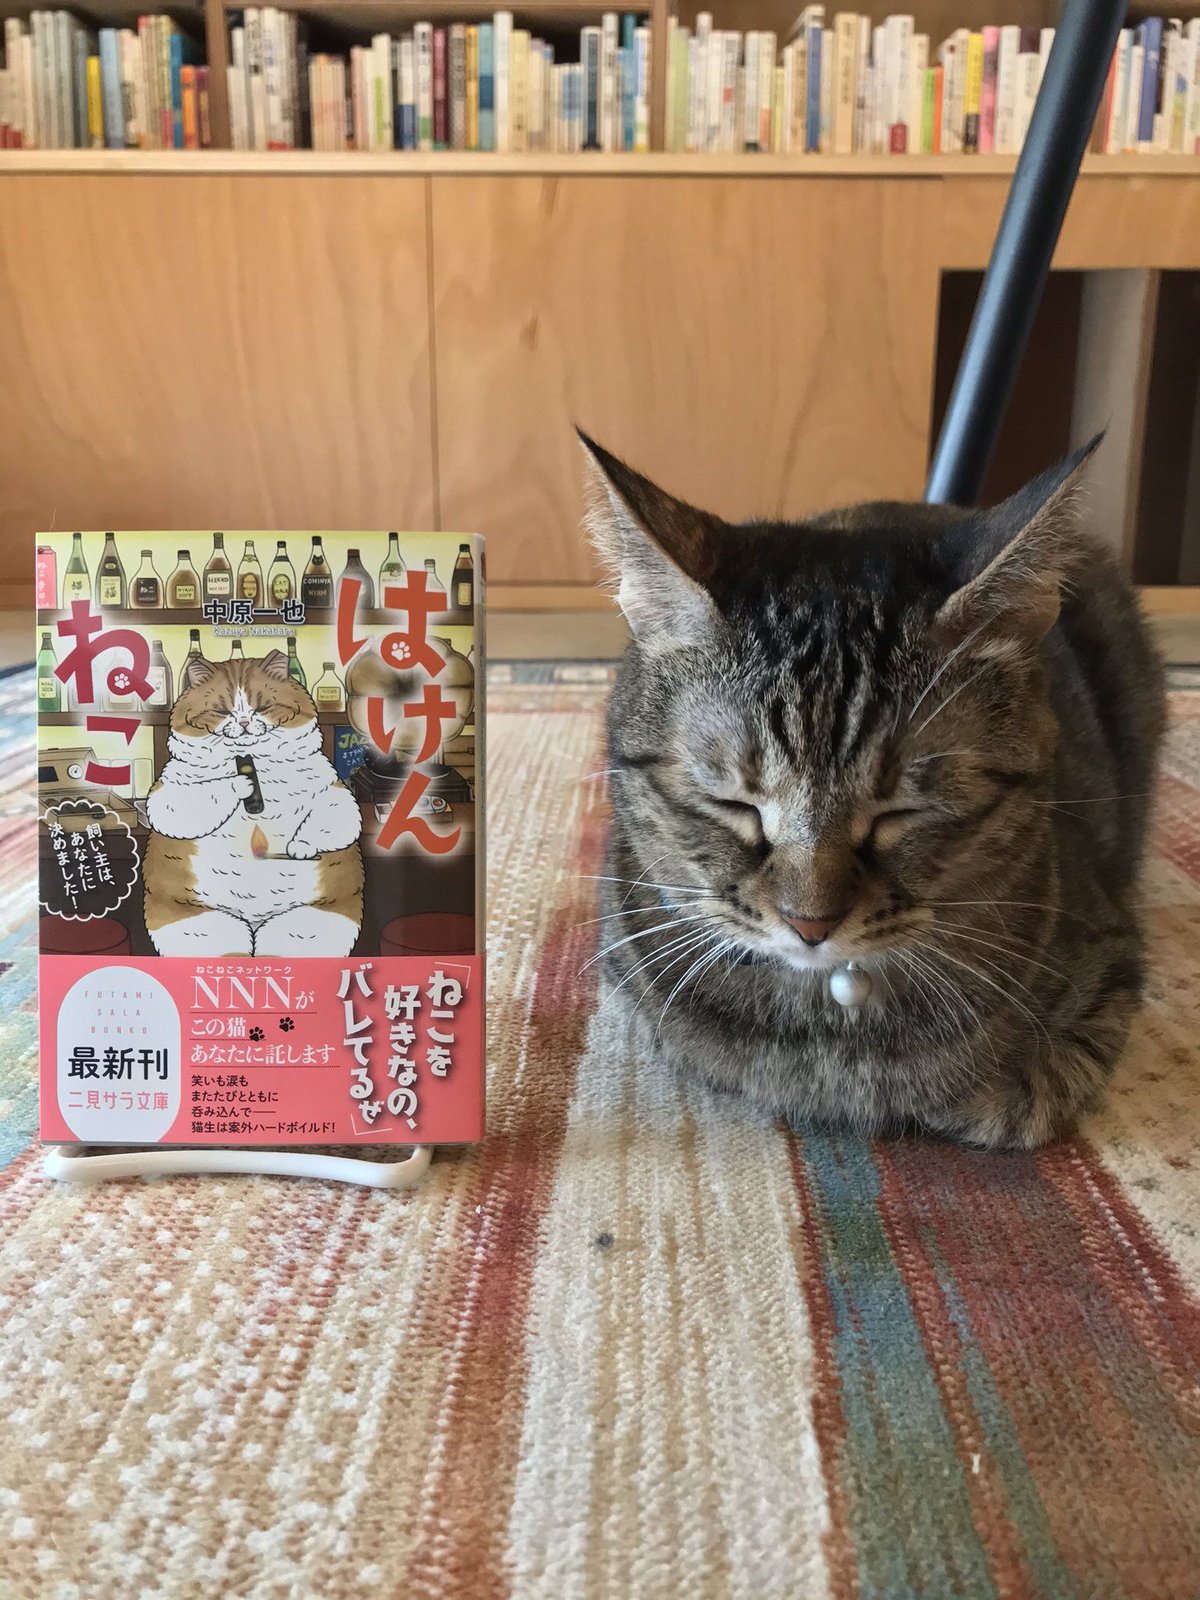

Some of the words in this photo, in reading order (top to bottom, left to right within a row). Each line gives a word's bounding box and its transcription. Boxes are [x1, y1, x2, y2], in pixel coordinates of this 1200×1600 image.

[203, 599, 306, 625] 中原一也
[214, 625, 248, 637] Kazuya
[249, 625, 295, 637] Nakahara
[54, 599, 156, 787] ねこ
[337, 570, 462, 855] はけん
[48, 820, 79, 909] 決めました！
[70, 831, 97, 892] あなたに
[85, 822, 116, 886] 飼い主は、
[195, 965, 292, 974] ねこねこネットワーク
[84, 991, 153, 999] FUTAMI
[97, 1008, 141, 1017] SALA
[190, 1016, 247, 1038] この猫
[67, 1046, 168, 1080] 最新刊
[190, 1043, 336, 1065] あなたに託します
[384, 984, 422, 1130] 好きなの、
[191, 1074, 249, 1087] 笑いも涙も
[68, 1090, 169, 1110] 二見サラ文庫
[191, 1089, 279, 1103] またたびとともに
[191, 1121, 336, 1134] 猫生は案外ハードボイルド！
